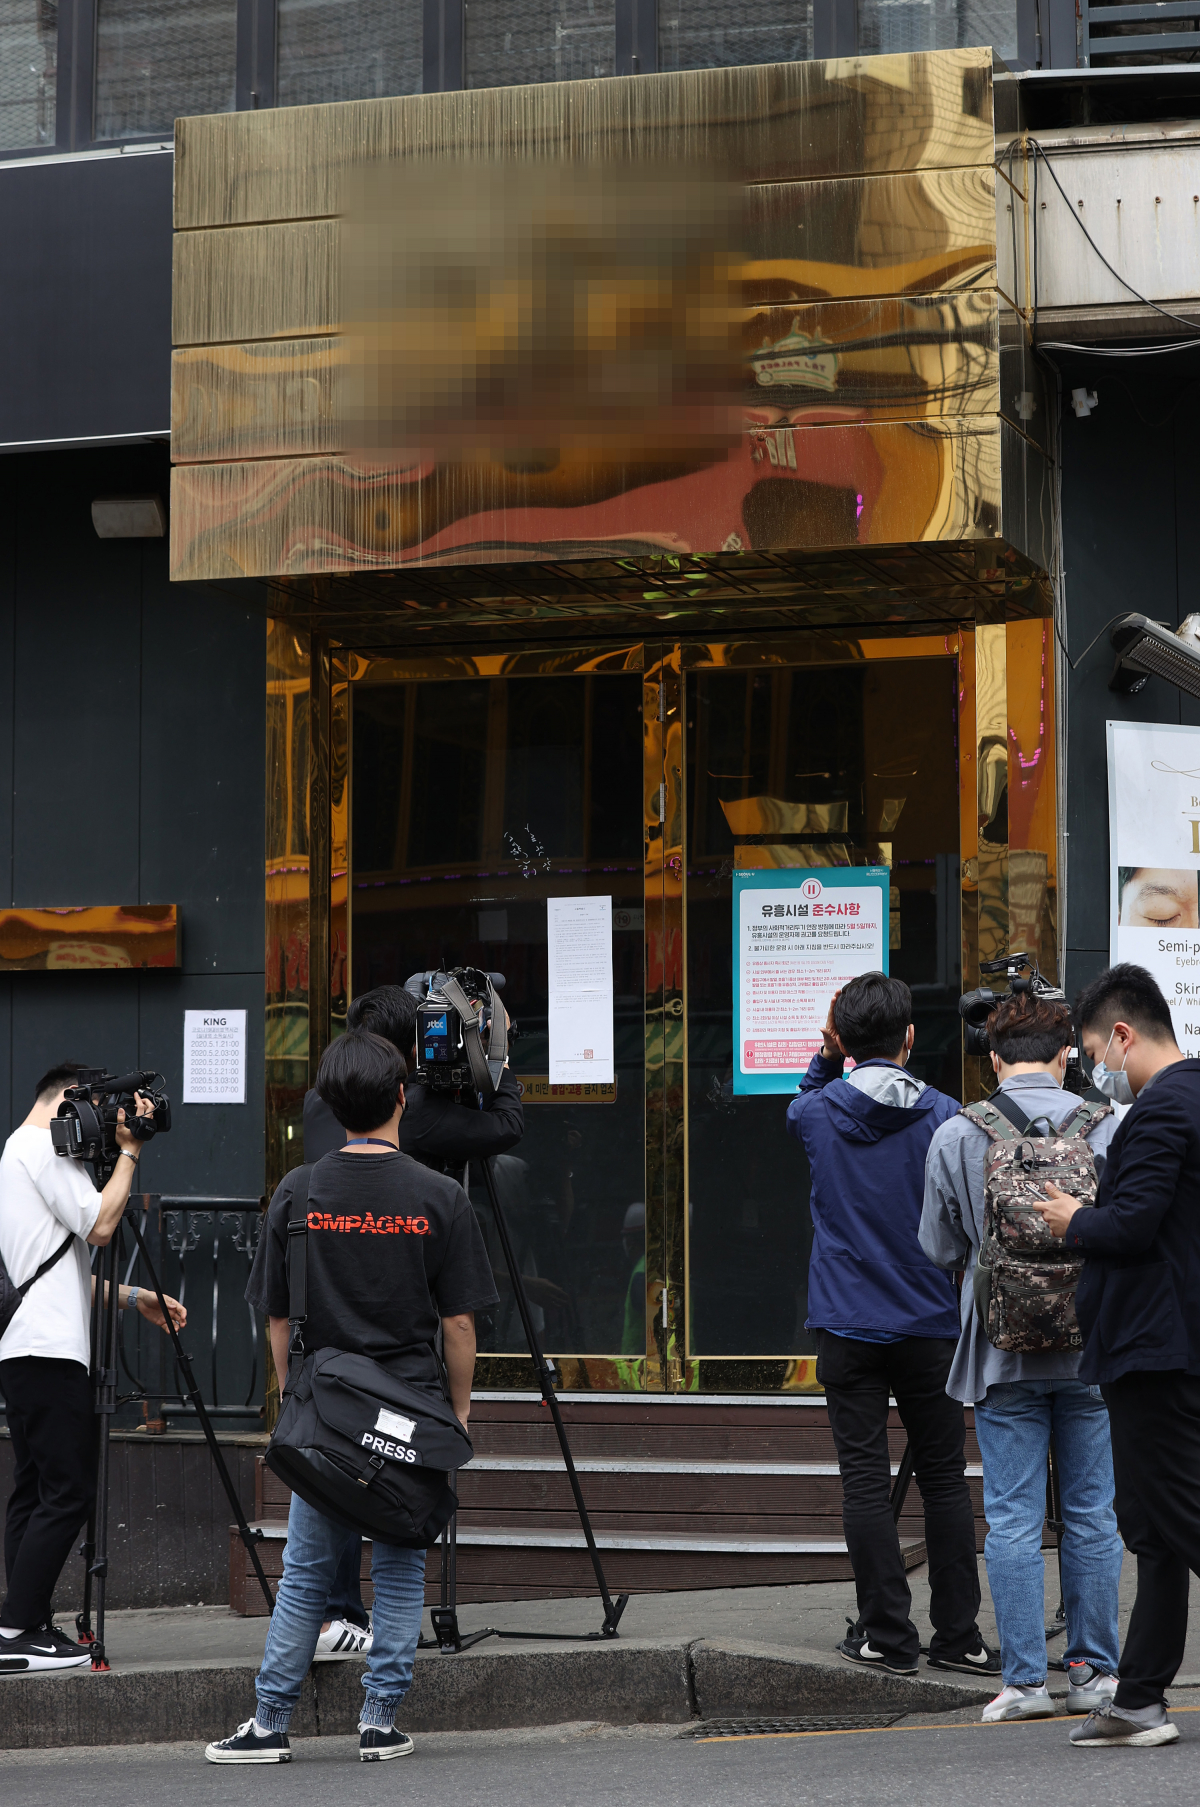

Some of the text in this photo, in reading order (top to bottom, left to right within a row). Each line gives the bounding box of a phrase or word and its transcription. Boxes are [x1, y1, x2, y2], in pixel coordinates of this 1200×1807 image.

[762, 902, 860, 917] 유흥시설 준수사항
[1176, 956, 1200, 967] Eyebr
[526, 1083, 533, 1095] 세
[536, 1083, 548, 1095] 미만
[584, 1084, 598, 1095] 금지
[601, 1083, 614, 1095] 업소
[307, 1212, 429, 1235] OMPAGNO
[361, 1432, 416, 1463] PRESS
